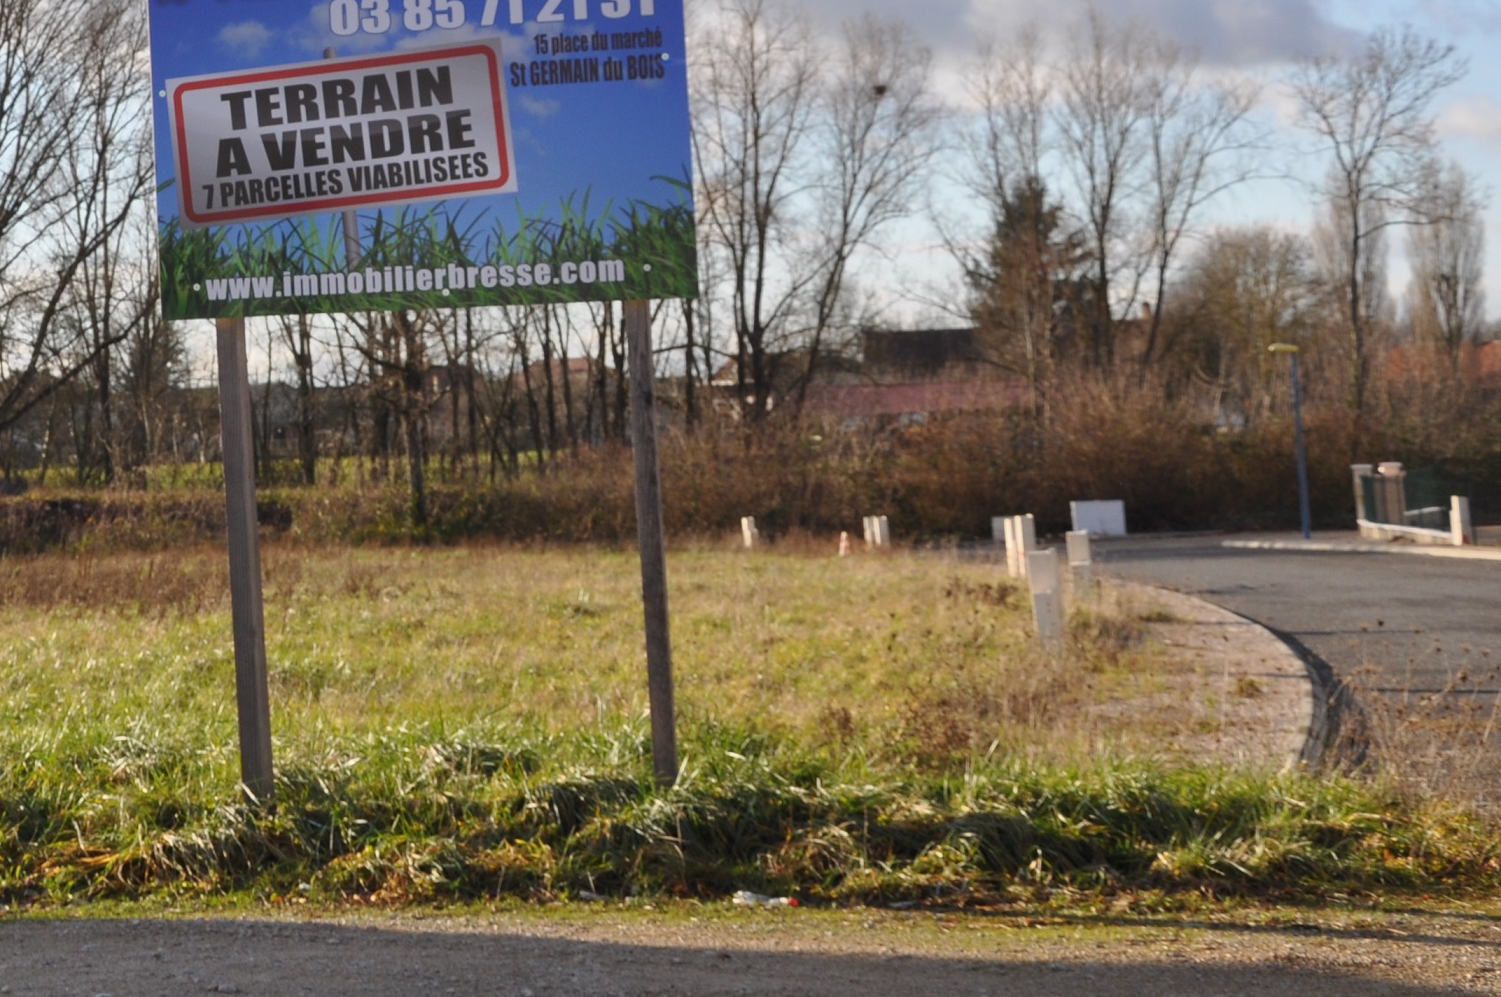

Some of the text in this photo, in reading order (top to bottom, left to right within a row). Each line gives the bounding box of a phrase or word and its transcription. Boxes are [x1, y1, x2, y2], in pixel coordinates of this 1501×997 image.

[533, 26, 663, 56] 15 place du marché
[510, 52, 665, 87] St GERMAIN du BOIS
[221, 65, 453, 130] TERRAIN
[216, 109, 476, 177] A VENDRE
[202, 151, 489, 209] 7 PARCELLES VIABILISEES
[206, 258, 625, 301] www.immobilierbresse.com
